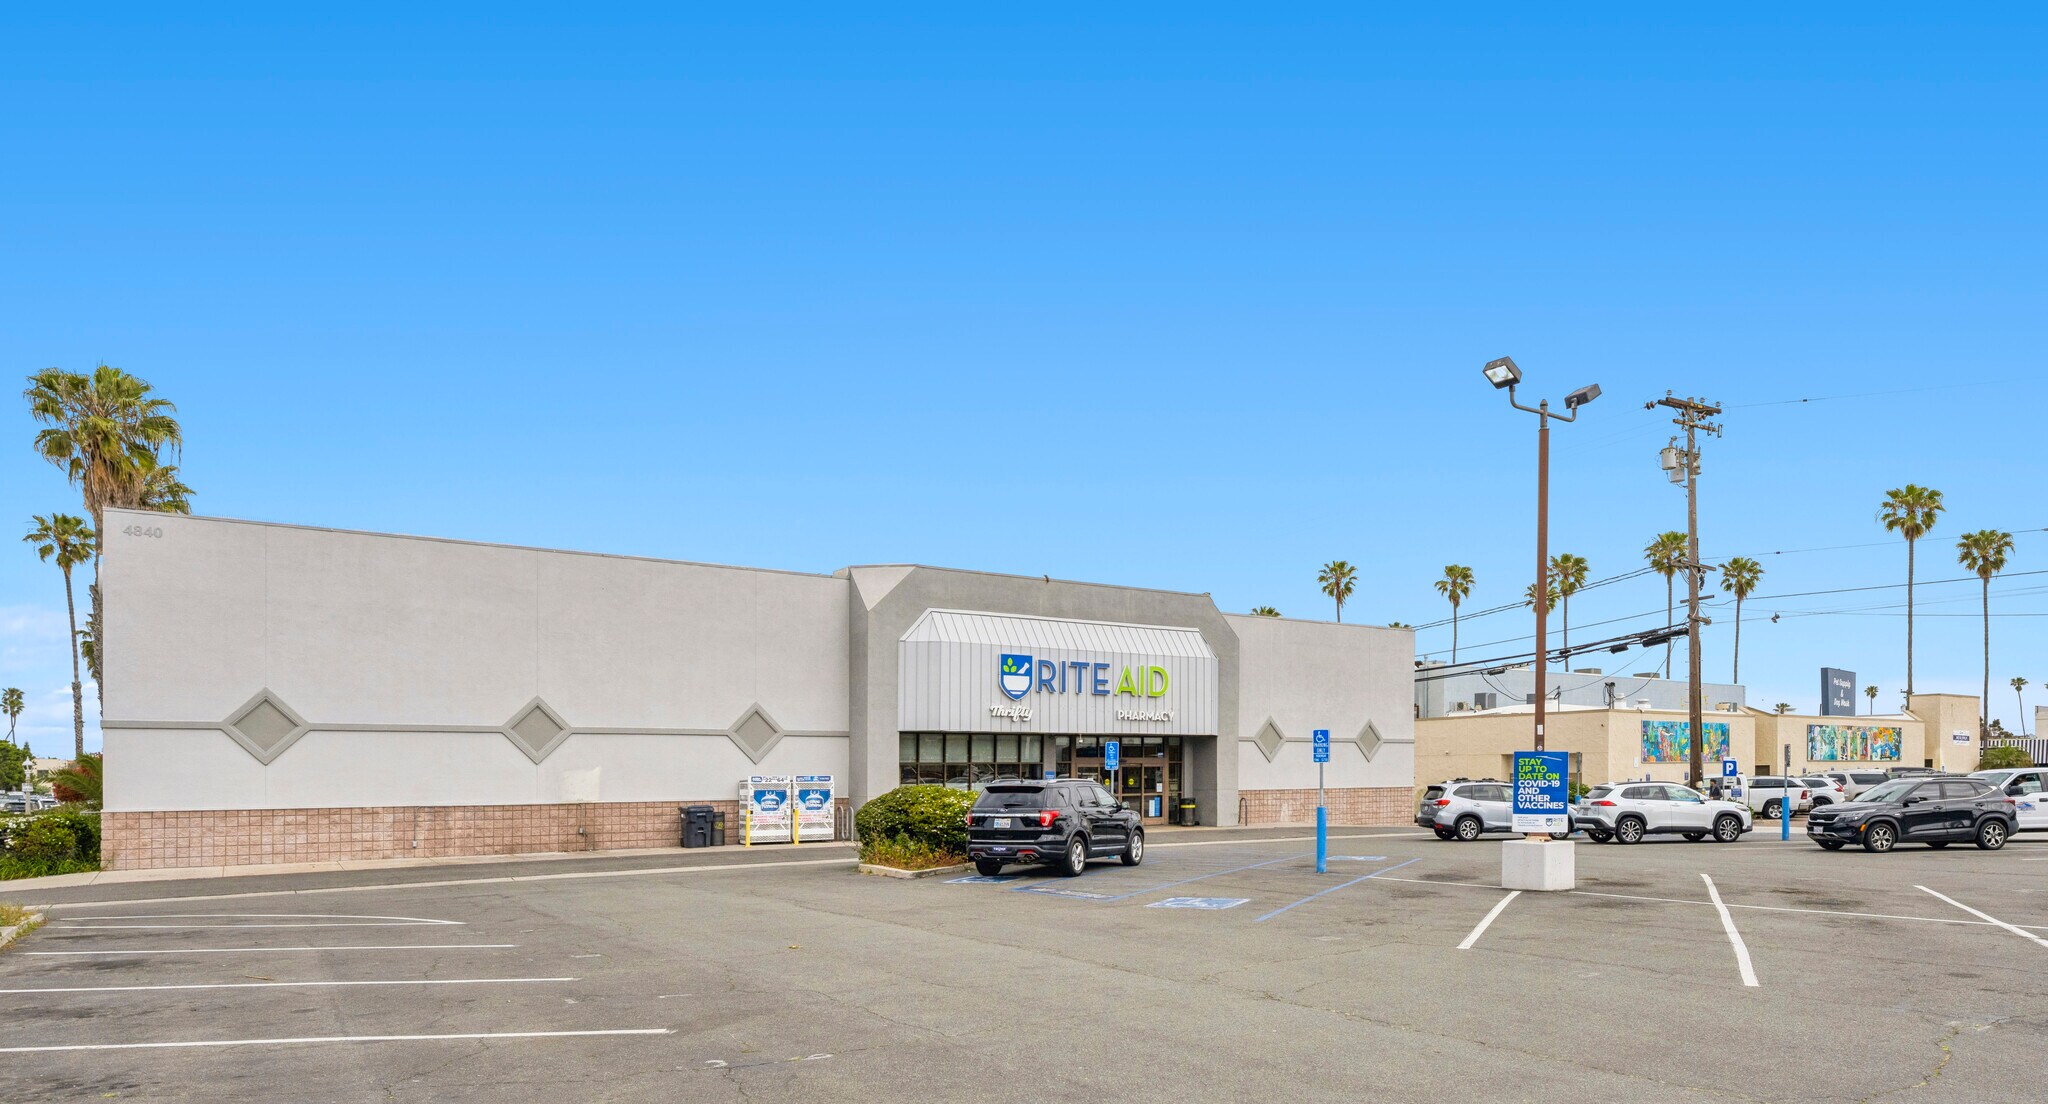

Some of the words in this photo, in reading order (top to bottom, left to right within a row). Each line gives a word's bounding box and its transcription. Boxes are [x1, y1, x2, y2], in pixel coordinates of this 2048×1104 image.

[122, 525, 163, 539] 4840
[1036, 659, 1111, 696] RITE
[1114, 664, 1169, 698] AID
[989, 705, 1034, 722] Thrifty
[1116, 709, 1175, 722] PHARMACY
[1518, 758, 1542, 766] STAY
[1518, 765, 1532, 773] UP
[1534, 765, 1547, 773] TO
[1725, 762, 1734, 775] P
[1518, 772, 1543, 780] DATE
[1545, 772, 1560, 780] ON
[1518, 787, 1540, 795] AND
[1518, 794, 1551, 802] OTHER
[1518, 801, 1564, 809] VACCINES
